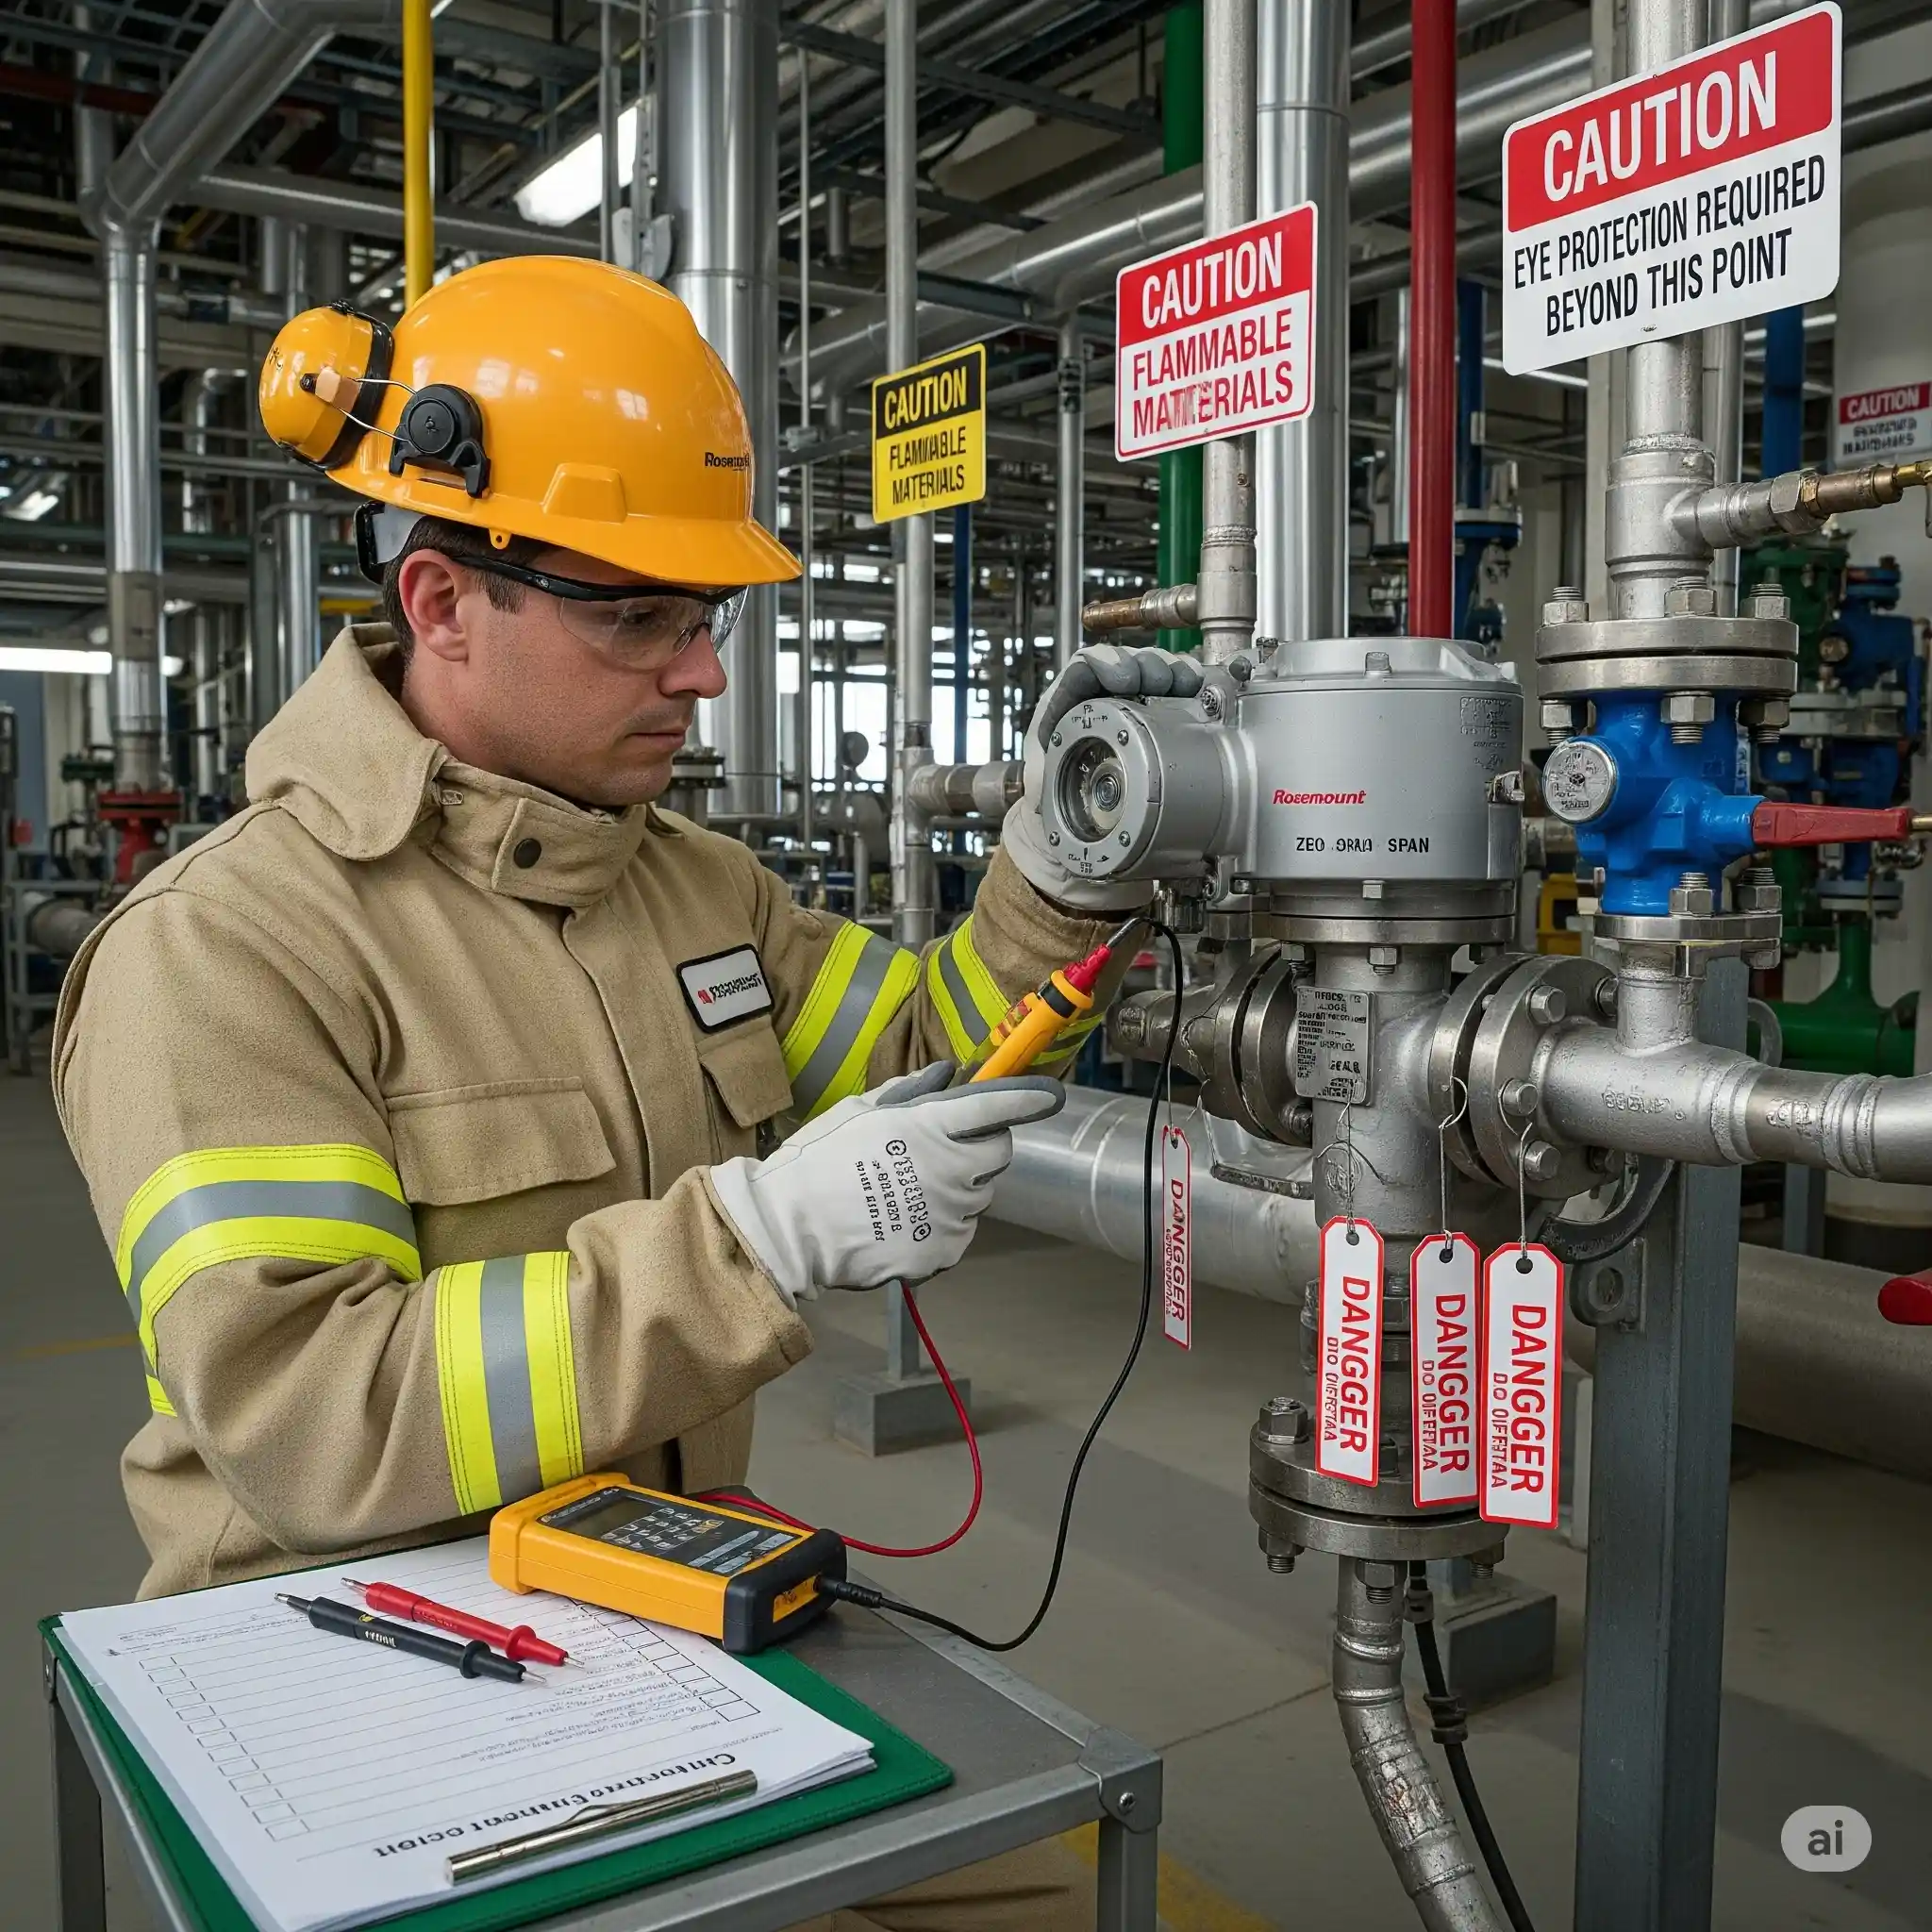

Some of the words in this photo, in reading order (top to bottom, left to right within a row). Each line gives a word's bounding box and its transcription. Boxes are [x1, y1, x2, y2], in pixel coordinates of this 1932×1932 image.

[1544, 51, 1776, 202] CAUTION
[1514, 240, 1551, 289] EYE
[1558, 197, 1687, 276] PROTECTION
[1697, 155, 1824, 236] REQUIRED
[1142, 231, 1282, 328] CAUTION
[1546, 272, 1637, 337] BEYOND
[1647, 253, 1703, 309] THIS
[1711, 227, 1792, 293] POINT
[884, 366, 967, 429] CAUTION
[1133, 308, 1291, 391] FLAMMABLE
[1847, 387, 1919, 420] CAUTION
[1274, 790, 1367, 805] Rosemount
[1388, 837, 1430, 853] SPAN
[1340, 1275, 1371, 1454] DANGGER
[1435, 1293, 1470, 1474] DANGGER
[1510, 1304, 1548, 1494] DANGGER
